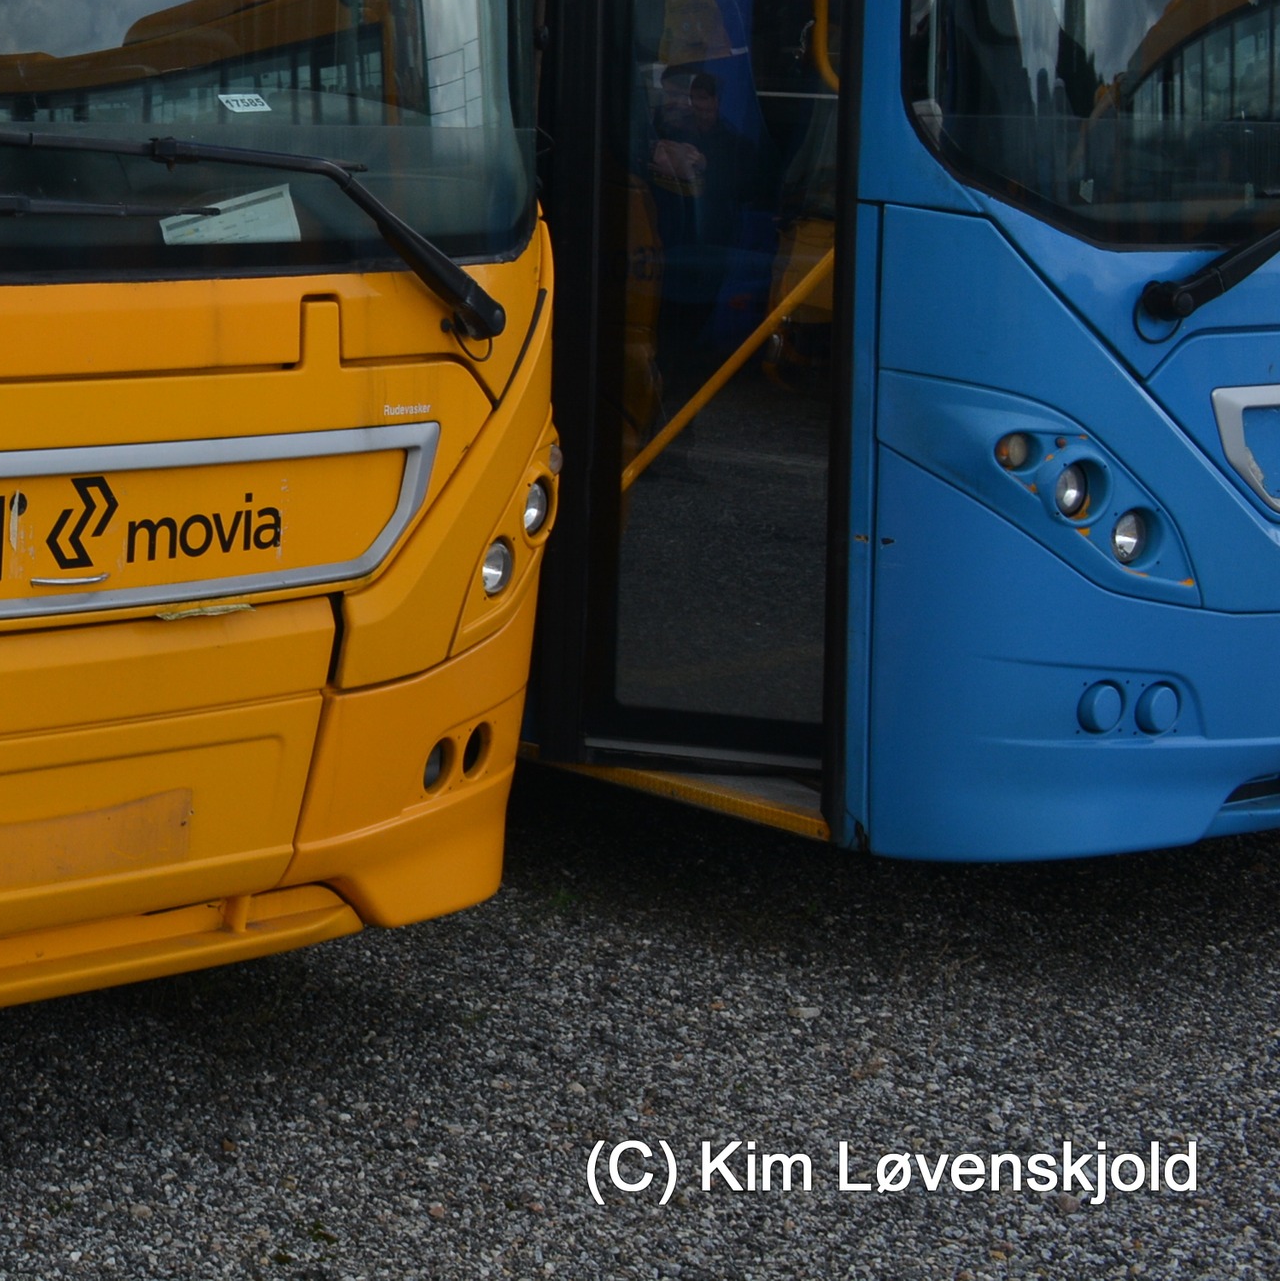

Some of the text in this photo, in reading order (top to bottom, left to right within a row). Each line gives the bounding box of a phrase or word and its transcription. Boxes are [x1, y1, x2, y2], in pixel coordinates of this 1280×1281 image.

[224, 97, 266, 109] 17585
[383, 403, 432, 417] Rudevasker
[126, 492, 282, 564] movia
